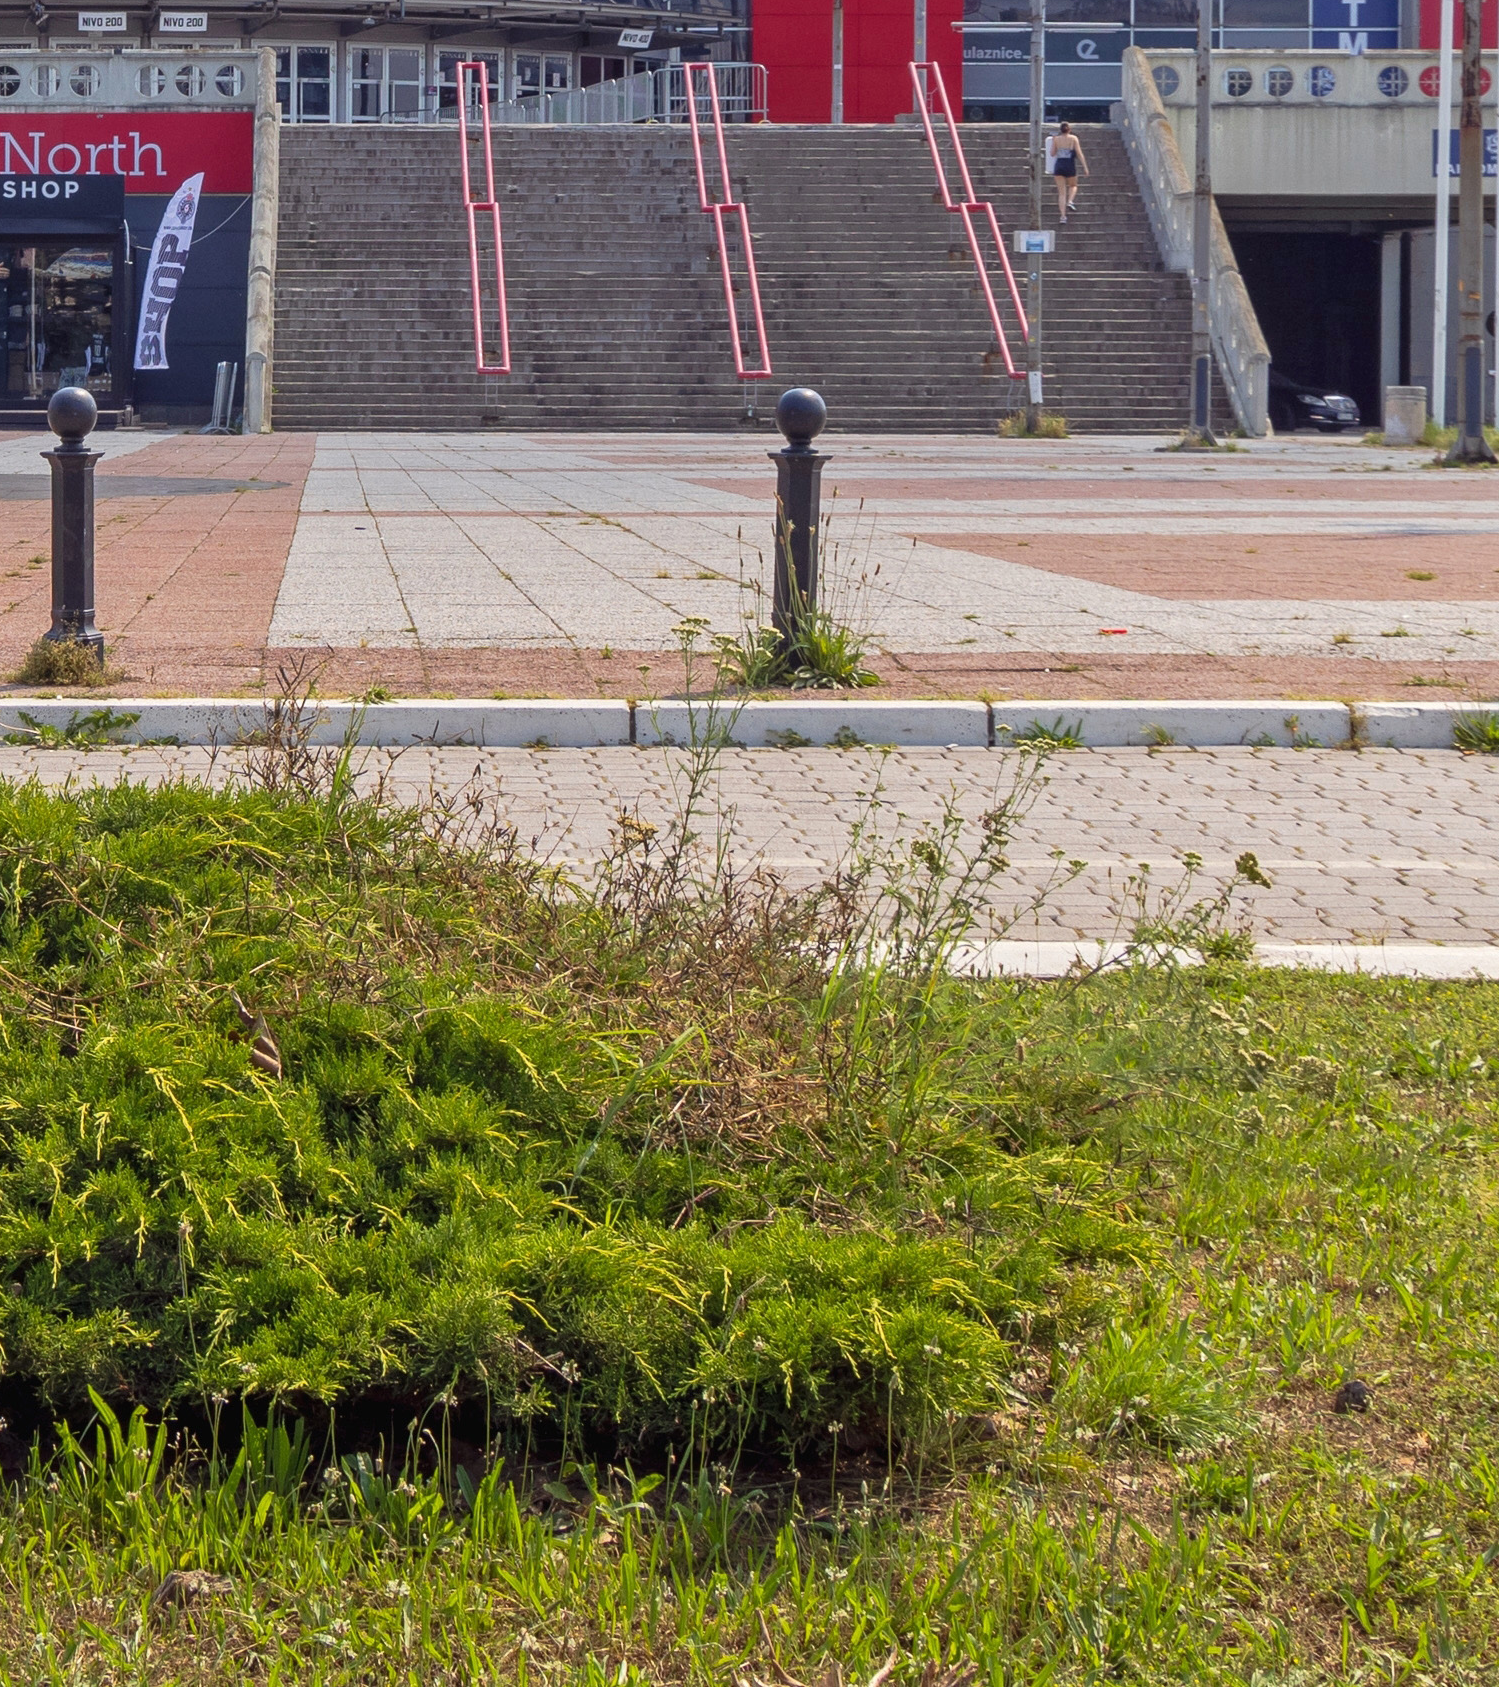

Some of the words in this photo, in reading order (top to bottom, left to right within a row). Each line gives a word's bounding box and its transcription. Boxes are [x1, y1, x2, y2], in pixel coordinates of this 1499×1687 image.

[82, 17, 103, 27] NIVO
[105, 17, 123, 27] 200
[163, 17, 184, 28] NIVO
[186, 18, 204, 28] 200
[0, 131, 167, 176] North
[2, 180, 80, 199] SHOP
[139, 233, 189, 366] SHOP
